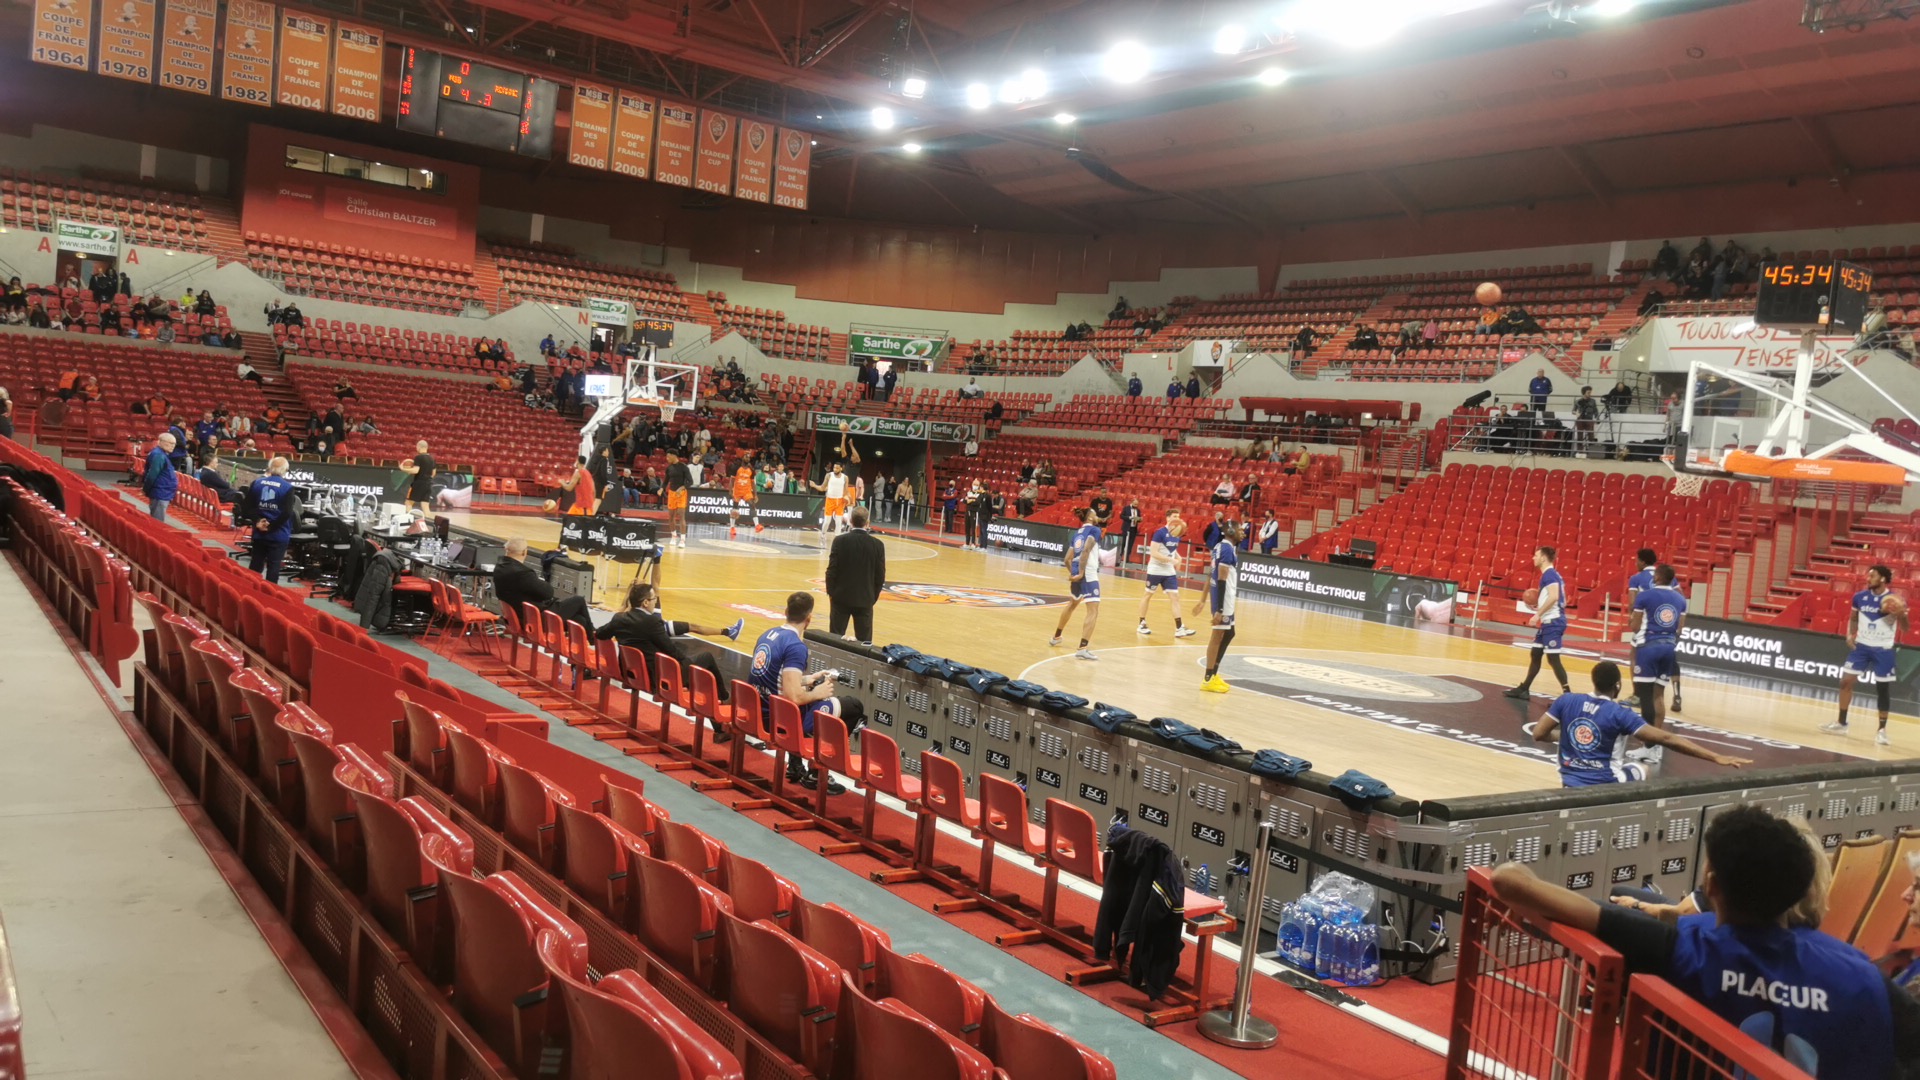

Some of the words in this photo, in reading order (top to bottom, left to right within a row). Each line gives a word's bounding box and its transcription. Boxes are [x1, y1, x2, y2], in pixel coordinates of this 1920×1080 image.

[43, 12, 83, 26] COUPE
[231, 1, 271, 26] SCM
[55, 25, 71, 34] DE
[104, 26, 152, 40] CHAMPION
[296, 20, 317, 33] MSB
[38, 31, 86, 46] FRANCE
[121, 38, 133, 46] DE
[350, 32, 371, 44] MSB
[109, 45, 144, 58] FRANCE
[167, 38, 211, 53] CHAMPION
[36, 47, 85, 67] 1964
[182, 51, 194, 59] DE
[228, 52, 270, 65] CHAMPION
[102, 60, 148, 78] 1978
[171, 58, 203, 70] FRANCE
[243, 64, 254, 72] DE
[288, 56, 320, 69] COUPE
[231, 71, 264, 83] FRANCE
[298, 68, 309, 77] DE
[338, 67, 378, 81] CHAMPION
[163, 72, 208, 90] 1979
[284, 75, 321, 89] FRANCE
[352, 79, 363, 87] DE
[225, 85, 268, 103] 1982
[339, 86, 375, 99] FRANCE
[586, 89, 603, 100] MSB
[282, 92, 321, 110] 2004
[628, 100, 645, 110] MSB
[337, 103, 376, 121] 2006
[670, 110, 686, 120] MSB
[575, 121, 608, 134] SEMAINE
[583, 131, 598, 140] DES
[621, 131, 645, 142] COUPE
[628, 141, 637, 149] DE
[660, 140, 691, 152] SEMAINE
[617, 147, 645, 159] FRANCE
[668, 150, 682, 158] DES
[700, 148, 730, 160] LEADERS
[572, 153, 604, 169] 2006
[707, 158, 721, 166] CUP
[744, 158, 765, 168] COUPE
[614, 161, 645, 178] 2009
[749, 167, 759, 175] DE
[778, 165, 807, 175] CHAMPION
[659, 171, 688, 187] 2009
[741, 173, 766, 184] FRANCE
[788, 174, 796, 182] DE
[698, 179, 727, 194] 2014
[779, 181, 804, 190] FRANCE
[739, 187, 766, 202] 2016
[347, 197, 368, 206] Salle
[777, 194, 804, 209] 2018
[346, 205, 391, 219] Christian
[393, 212, 437, 227] BALTZER
[60, 225, 90, 235] Sarthe
[37, 236, 52, 253] A
[59, 240, 116, 253] www.sarthe.fr
[126, 248, 139, 264] A
[1764, 265, 1833, 286] 45:34
[1840, 266, 1872, 292] 45:34
[577, 312, 589, 325] N
[647, 321, 673, 331] 45:34
[863, 337, 900, 350] Sarthe
[1747, 347, 1848, 368] ENSEBLE
[1599, 355, 1613, 375] K
[815, 414, 847, 425] Sarthe
[878, 420, 906, 431] Sarthe
[932, 424, 953, 435] Sarthe
[690, 495, 730, 506] JUSQU'À
[756, 508, 803, 519] LECTRIQUE
[1008, 526, 1028, 536] 60KM
[612, 537, 653, 549] SPALDING
[1023, 537, 1064, 552] ÉLECTRIQUE
[1240, 561, 1281, 577] JUSQU'À
[1281, 567, 1310, 581] 60KM
[1240, 572, 1304, 592] D'AUTONOMIE
[1304, 581, 1366, 601] ÉLECTRIQUE
[1680, 626, 1730, 646] SQU'À
[1733, 634, 1782, 654] 60KM
[1674, 641, 1772, 667] AUTONOMIE
[1288, 694, 1422, 726] Mutuel
[1145, 808, 1163, 820] JSG
[1199, 826, 1218, 841] JSG
[1270, 851, 1291, 867] JSG
[1721, 968, 1830, 1013] PLACEUR
